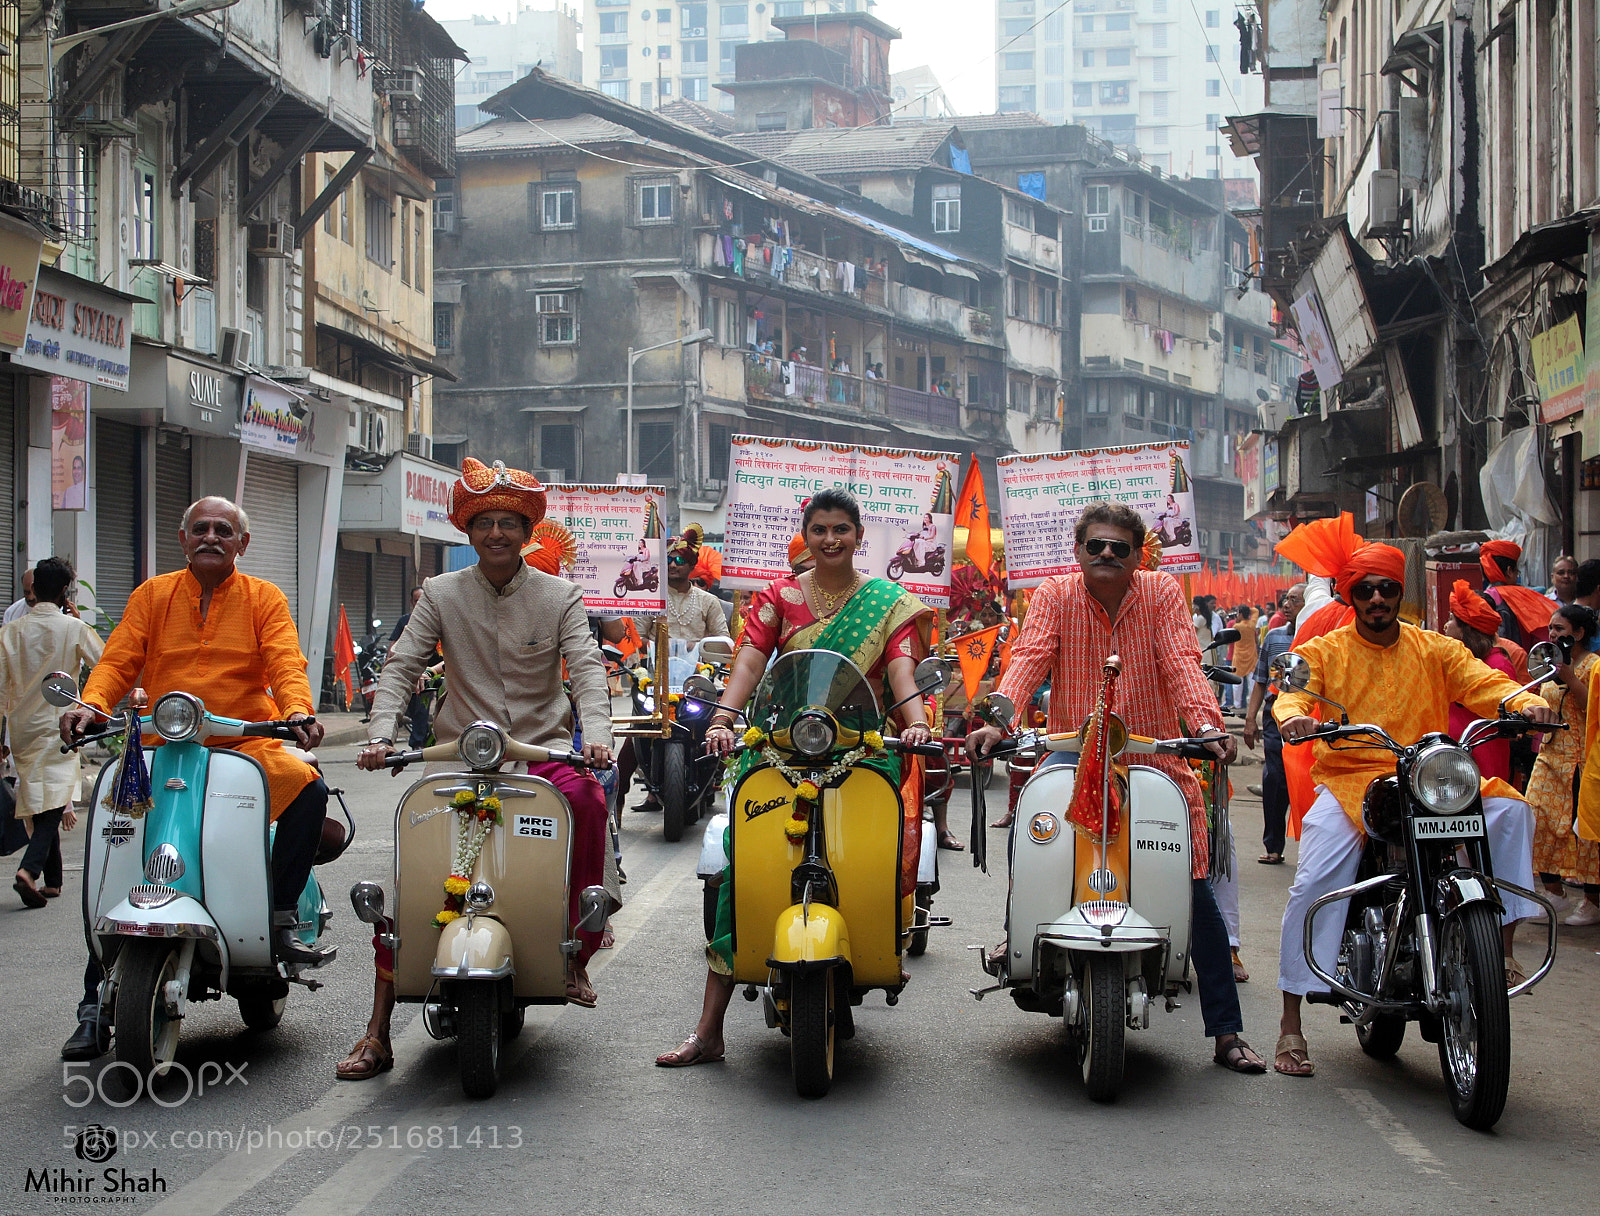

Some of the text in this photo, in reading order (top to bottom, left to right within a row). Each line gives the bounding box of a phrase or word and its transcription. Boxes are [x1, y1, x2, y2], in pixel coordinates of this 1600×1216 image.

[74, 302, 125, 348] SIYARA
[189, 370, 222, 407] SUAVE
[1088, 479, 1122, 491] BIKE)
[564, 516, 597, 529] BIKE)
[744, 796, 790, 822] Vespa
[519, 816, 552, 827] MRC
[1418, 820, 1479, 834] MMJ.4010
[519, 827, 552, 838] 586
